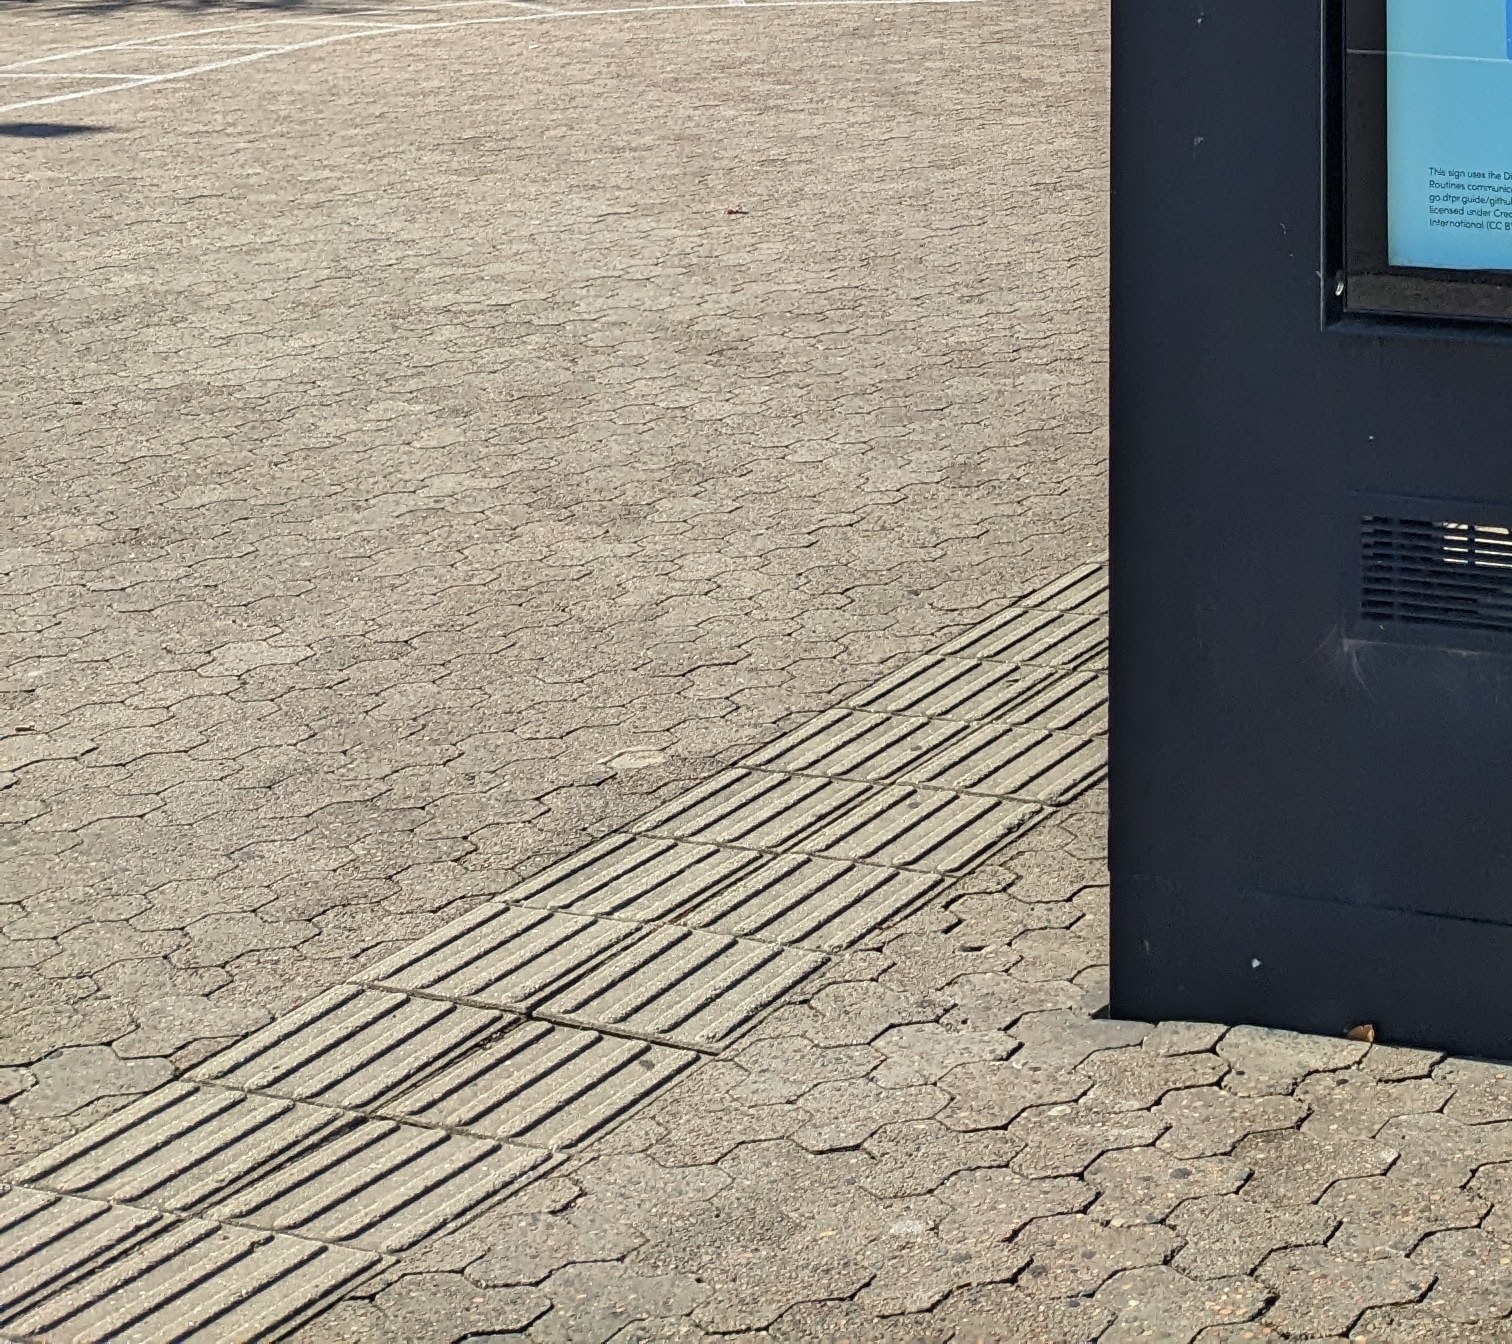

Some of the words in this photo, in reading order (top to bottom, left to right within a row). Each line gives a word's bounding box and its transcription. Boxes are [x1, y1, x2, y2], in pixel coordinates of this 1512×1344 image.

[1488, 171, 1501, 180] the
[1429, 180, 1465, 190] Routines
[1429, 218, 1484, 229] International
[1486, 221, 1502, 230] (CC
